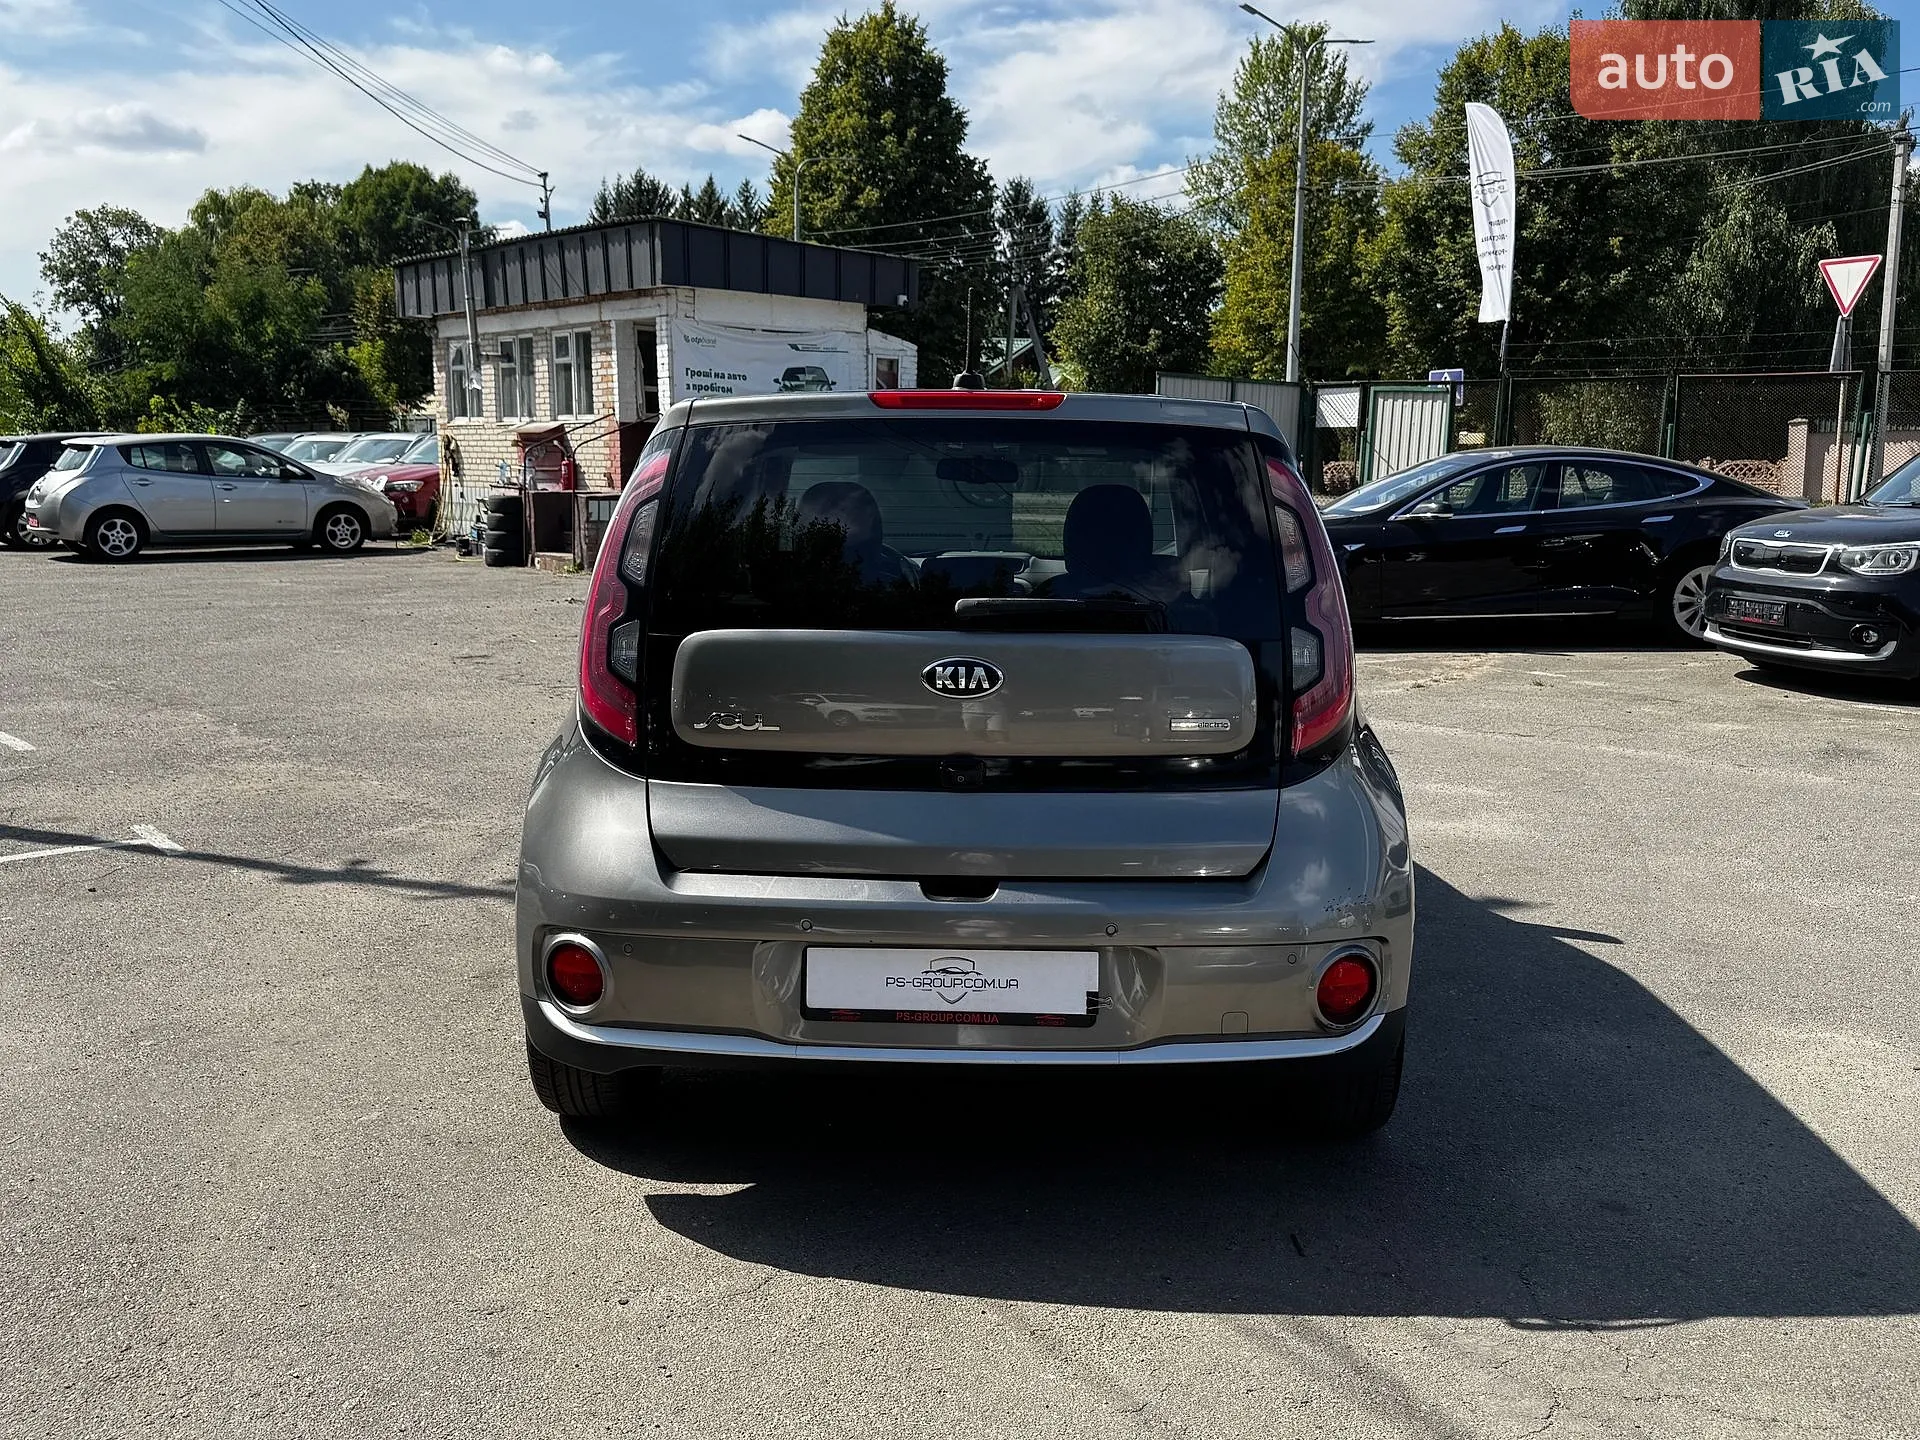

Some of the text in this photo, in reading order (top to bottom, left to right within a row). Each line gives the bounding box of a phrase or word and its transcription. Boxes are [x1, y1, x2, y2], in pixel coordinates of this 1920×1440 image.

[685, 367, 747, 381] Гроші на авто
[685, 382, 733, 394] з пробігом
[935, 667, 990, 689] KIA
[693, 712, 780, 731] SOUL
[885, 976, 1019, 989] PS-GROUP.COM.UA
[896, 1012, 999, 1023] PS-GROUP.COM.UA
